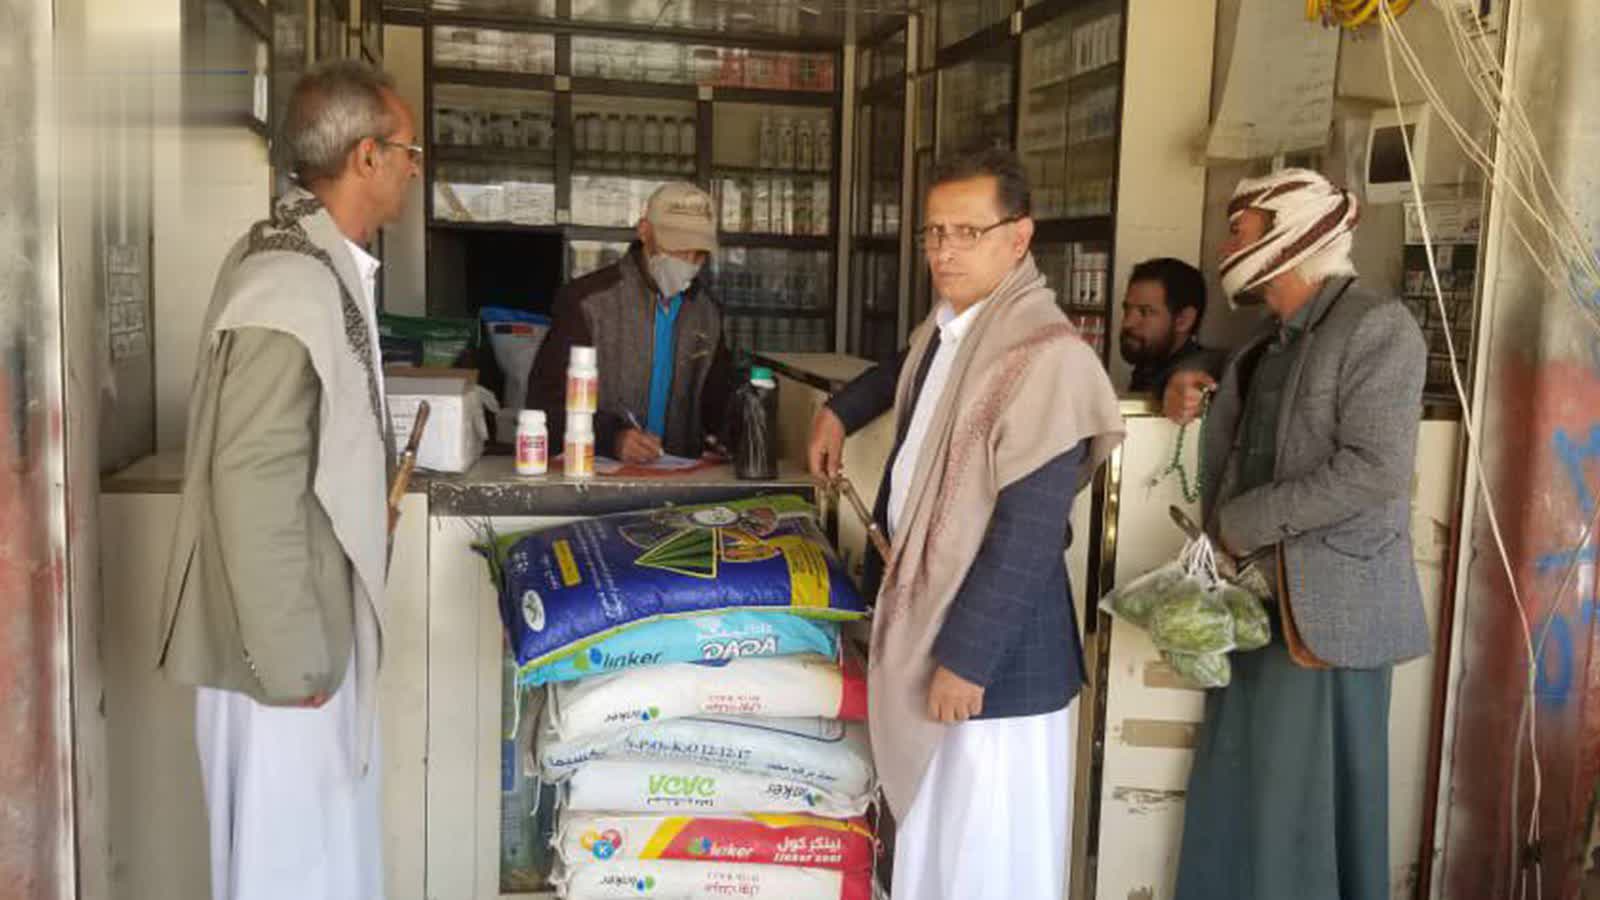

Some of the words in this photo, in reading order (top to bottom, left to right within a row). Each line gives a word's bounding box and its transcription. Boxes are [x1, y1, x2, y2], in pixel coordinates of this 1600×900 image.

[703, 636, 777, 659] DADA
[603, 651, 662, 669] linker
[711, 841, 753, 857] linker
